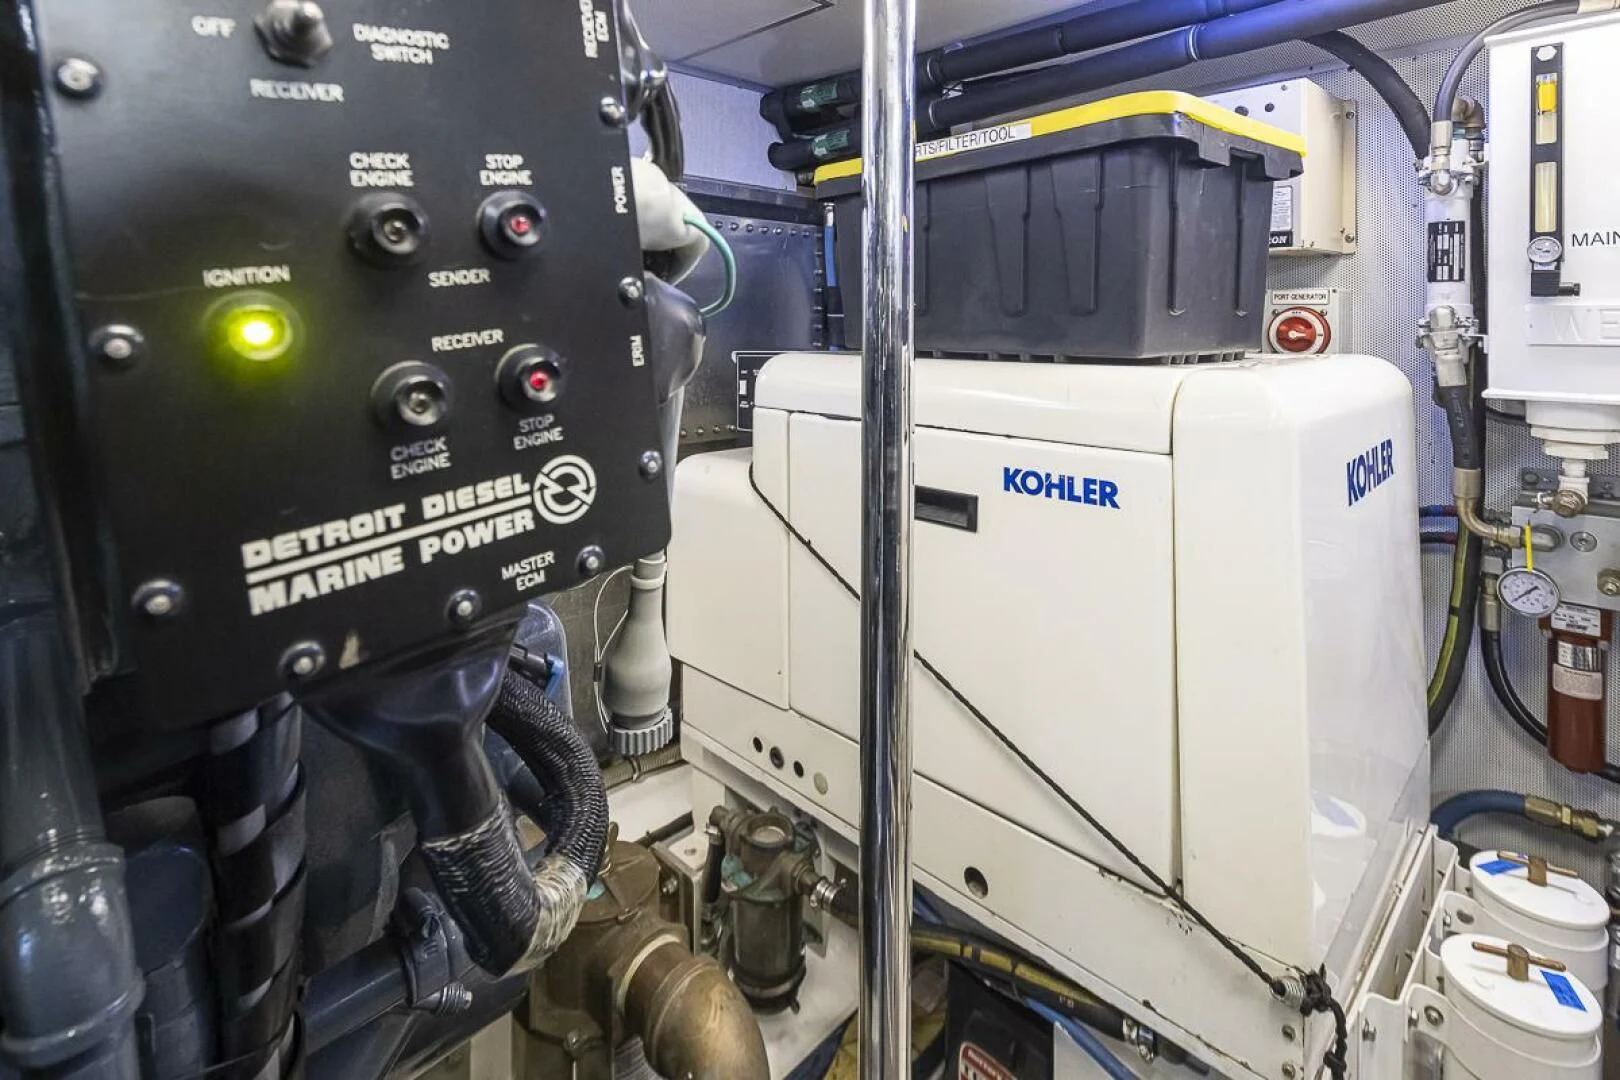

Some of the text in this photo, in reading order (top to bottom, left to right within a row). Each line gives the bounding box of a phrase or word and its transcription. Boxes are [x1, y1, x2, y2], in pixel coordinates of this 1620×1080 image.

[191, 15, 236, 38] OFF
[352, 23, 450, 50] DIAGNOSTIC
[370, 43, 433, 65] SWITCH
[250, 78, 344, 102] RECEIVER
[349, 152, 410, 170] CHECK
[485, 154, 524, 170] STOP
[349, 169, 414, 187] ENGINE
[479, 169, 533, 186] ENGINE
[611, 166, 628, 214] POWER
[203, 264, 291, 288] IGNITION
[428, 268, 491, 288] SENDER
[431, 329, 504, 352] RECEIVER
[629, 334, 645, 367] ERM
[519, 414, 555, 433] STOP
[390, 436, 448, 462] CHECK
[513, 427, 563, 451] ENGINE
[391, 452, 451, 480] ENGINE
[1346, 438, 1394, 506] KOHLER
[1003, 467, 1120, 510] KOHLER
[241, 473, 531, 569] DETROIT DIESEL
[248, 508, 536, 616] MARINE POWER
[501, 551, 556, 581] MASTER
[516, 571, 546, 592] ECM
